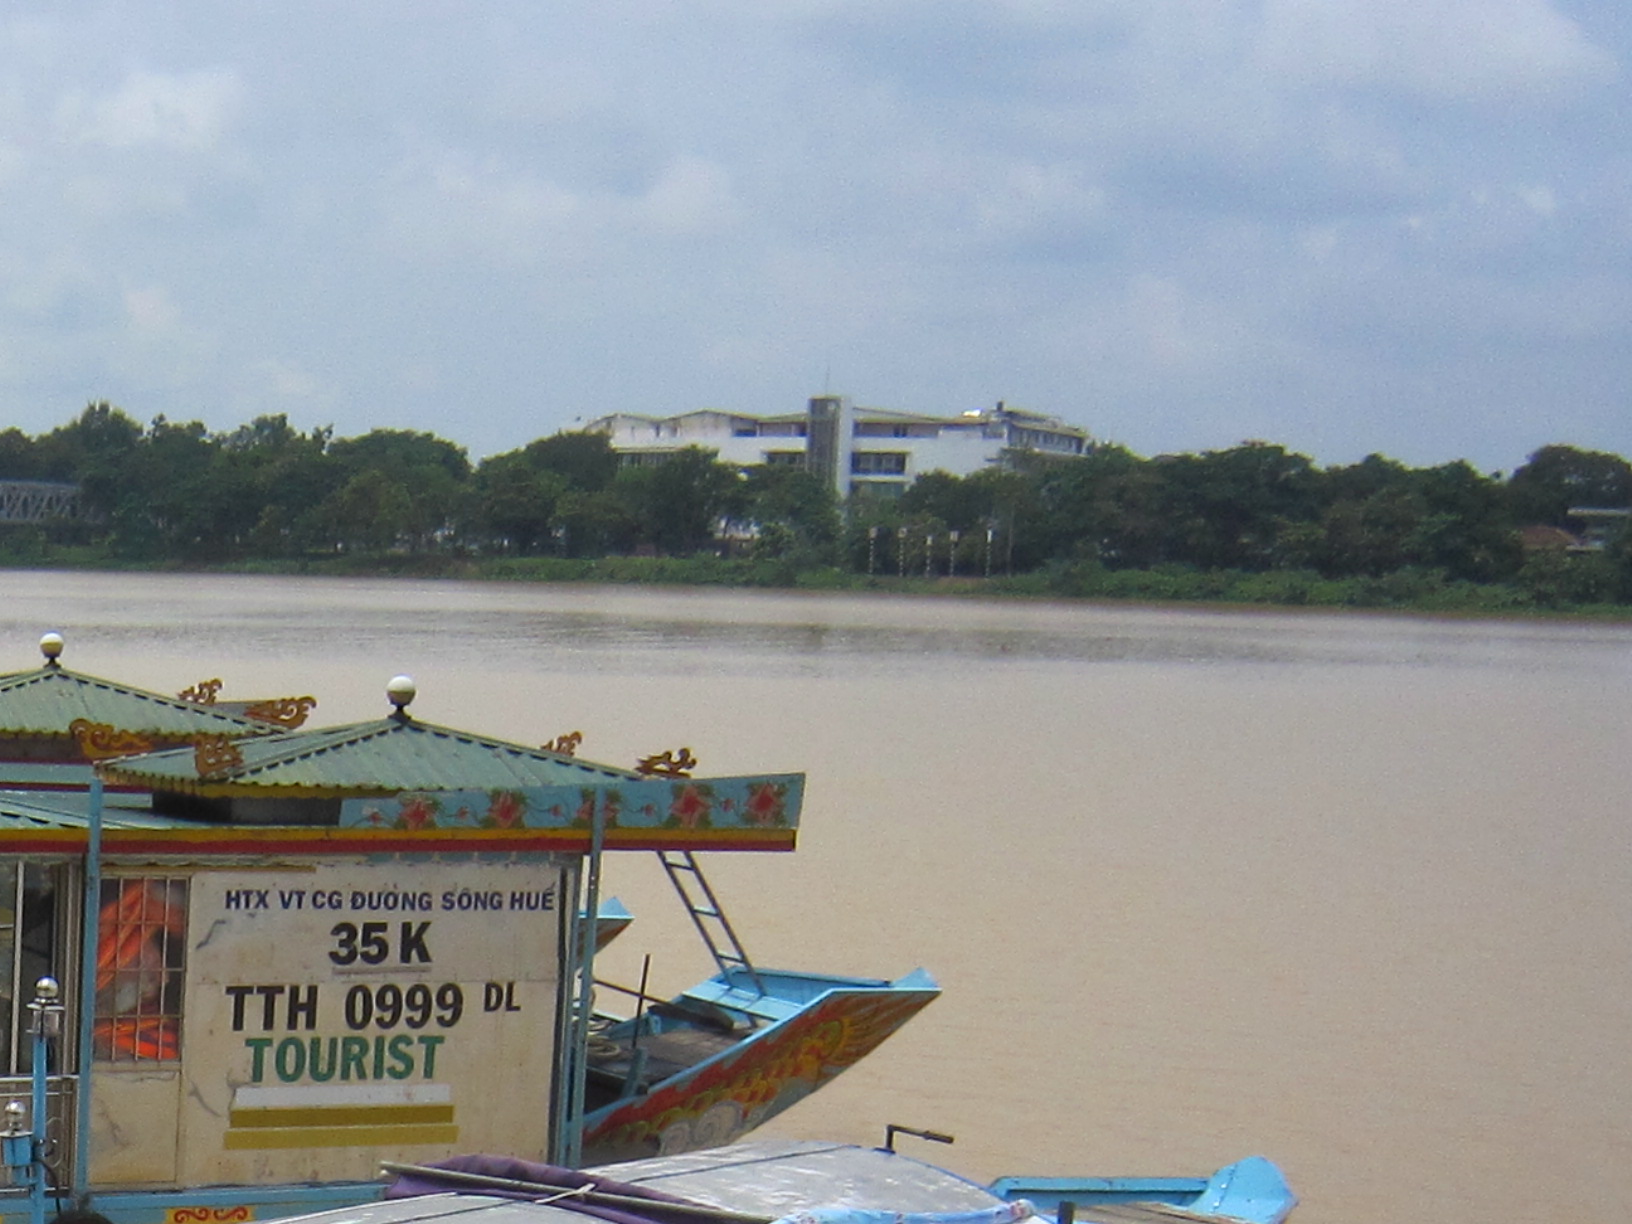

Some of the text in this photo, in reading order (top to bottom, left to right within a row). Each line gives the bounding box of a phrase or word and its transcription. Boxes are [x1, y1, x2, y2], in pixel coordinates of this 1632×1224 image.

[225, 889, 269, 910] HTX
[279, 890, 306, 910] VT
[312, 891, 343, 910] CG
[225, 981, 521, 1031] TTH 0999 DL
[245, 1035, 445, 1083] TOURIST
